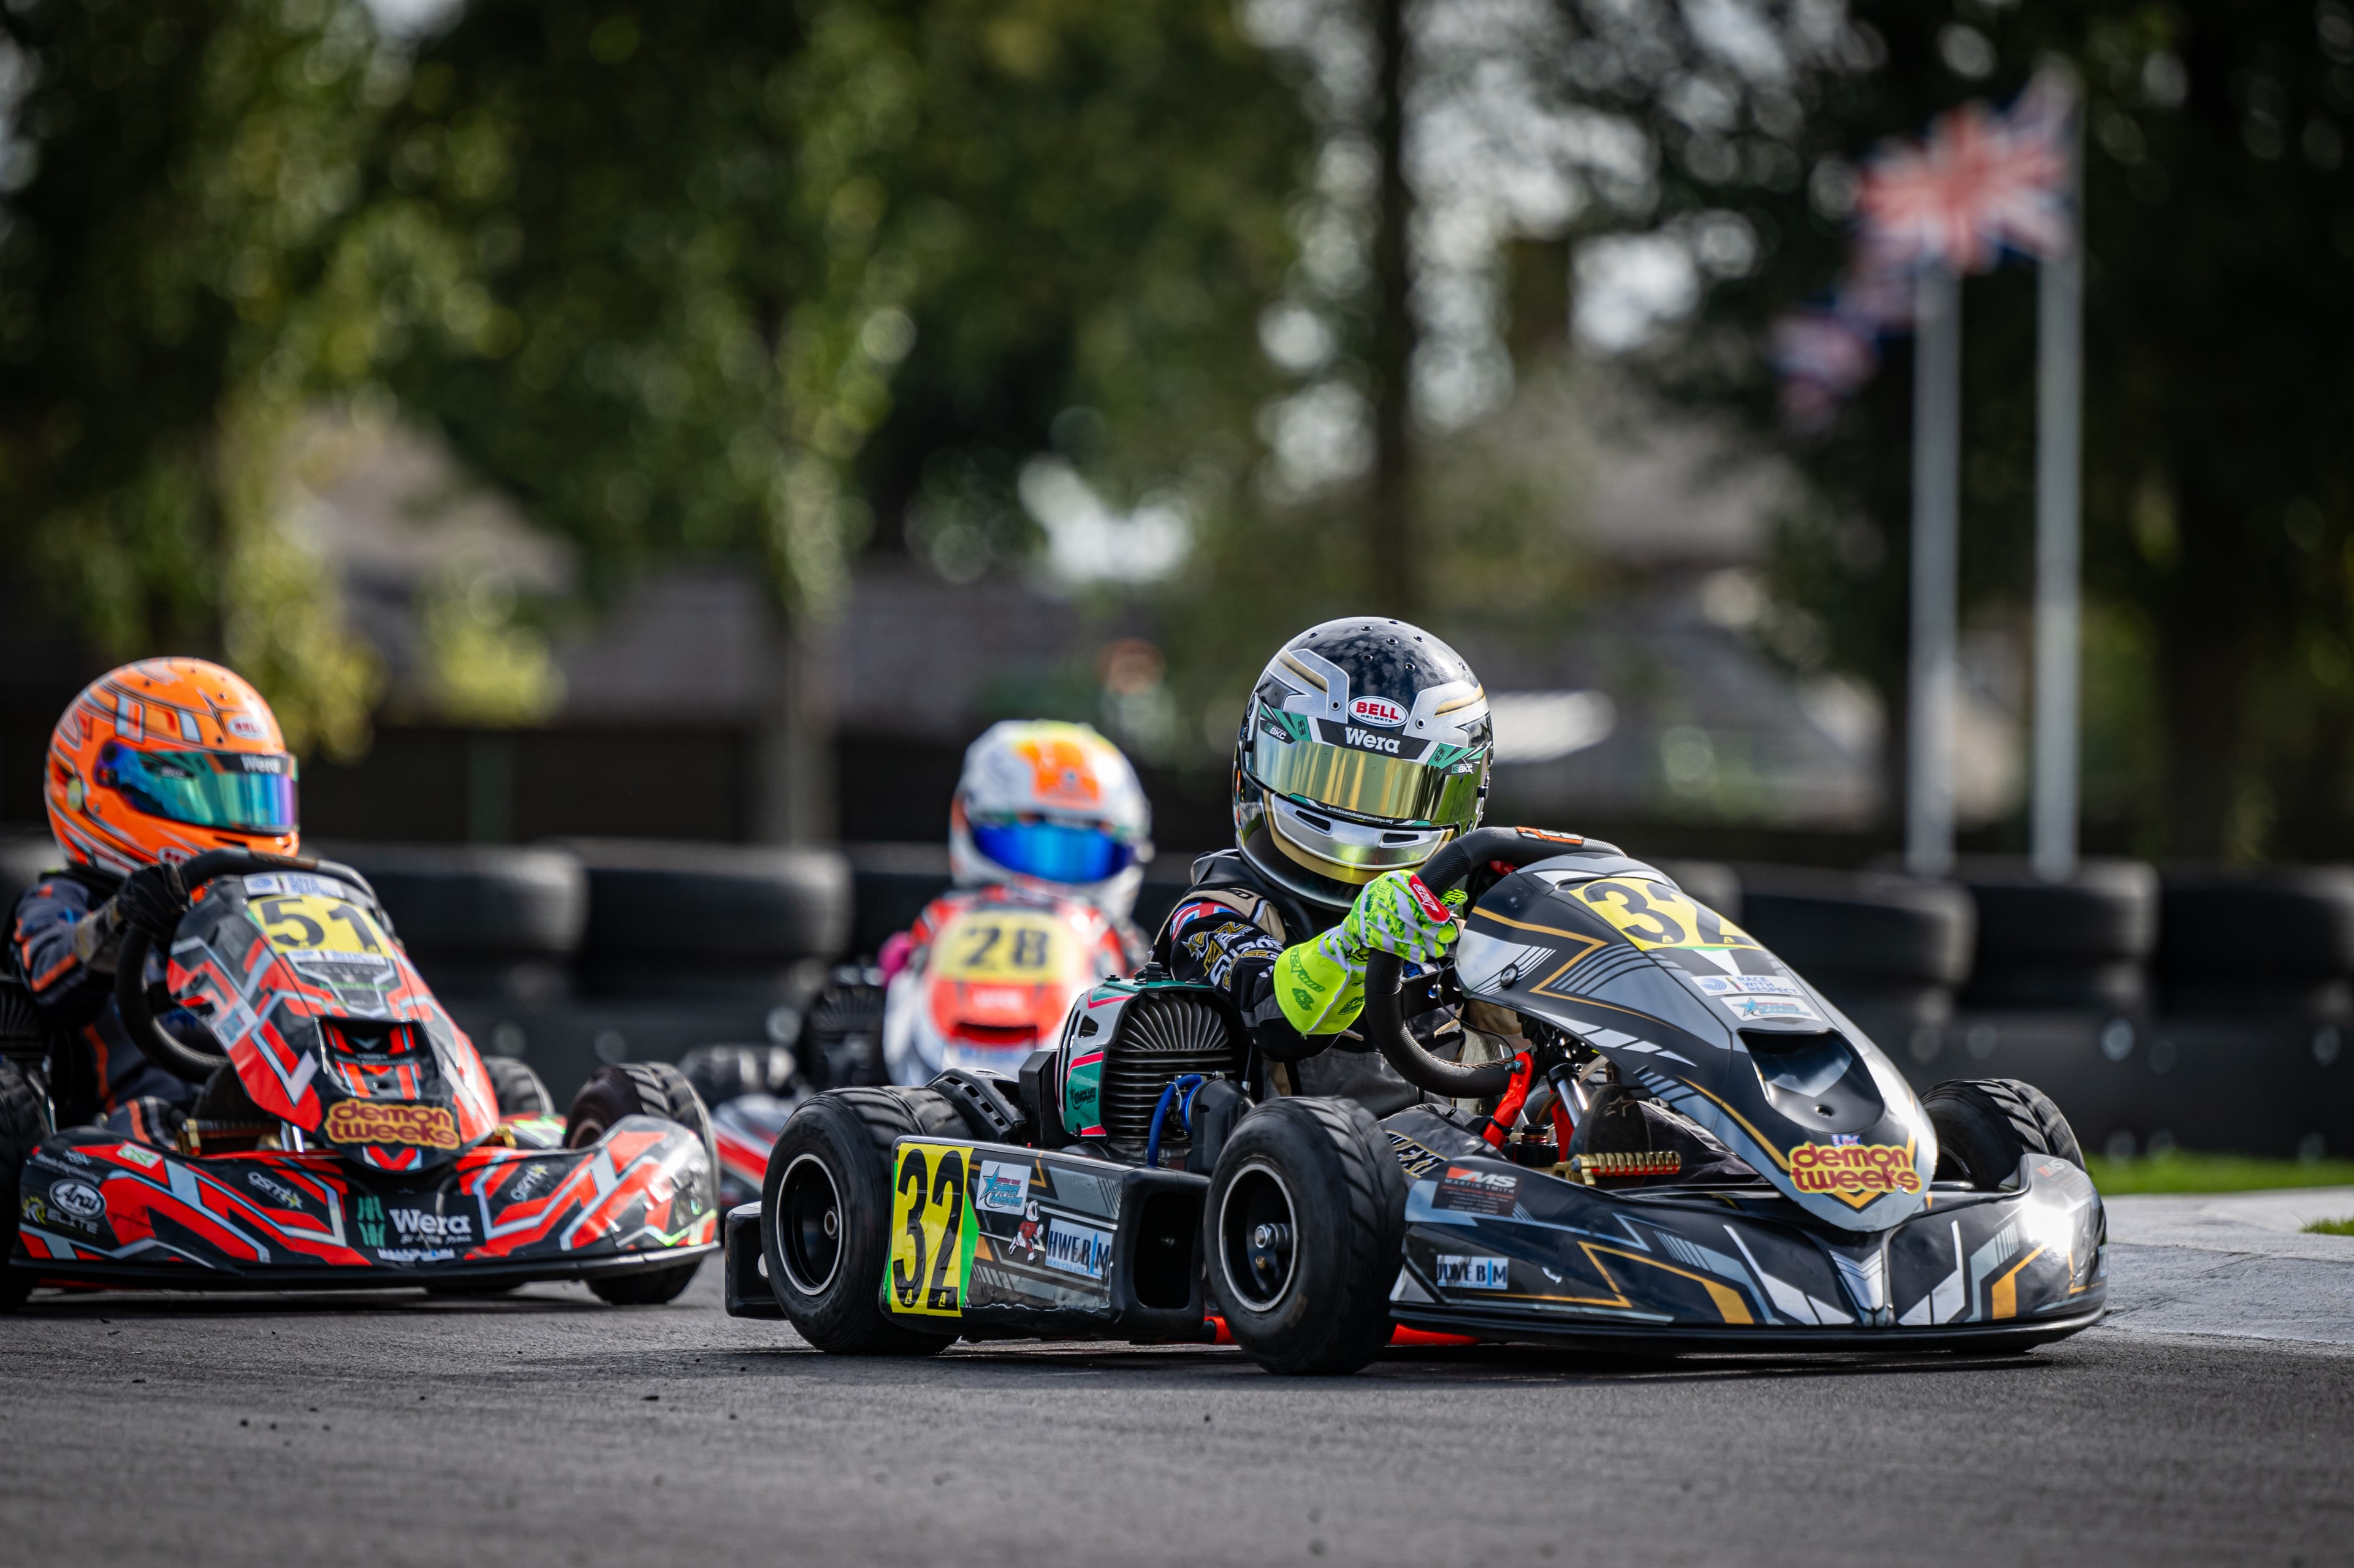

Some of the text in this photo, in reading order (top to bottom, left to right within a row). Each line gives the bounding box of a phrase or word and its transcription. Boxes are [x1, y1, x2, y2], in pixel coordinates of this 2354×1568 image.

[1356, 702, 1399, 720] BELL
[1360, 714, 1393, 723] HELMETS
[1270, 728, 1287, 740] BKC
[1345, 727, 1400, 754] Wera
[261, 899, 381, 953] 51
[1583, 881, 1758, 947] 32
[964, 926, 1050, 970] 28
[333, 1102, 451, 1127] demon
[330, 1121, 456, 1146] tweeks
[1793, 1138, 1910, 1168] demon
[1444, 1178, 1515, 1194] MARTIN SMITH
[1459, 1171, 1517, 1188] MS
[1791, 1165, 1919, 1191] tweeks
[389, 1209, 471, 1236] Wera
[893, 1148, 964, 1311] 32
[1046, 1258, 1072, 1271] SERVICES
